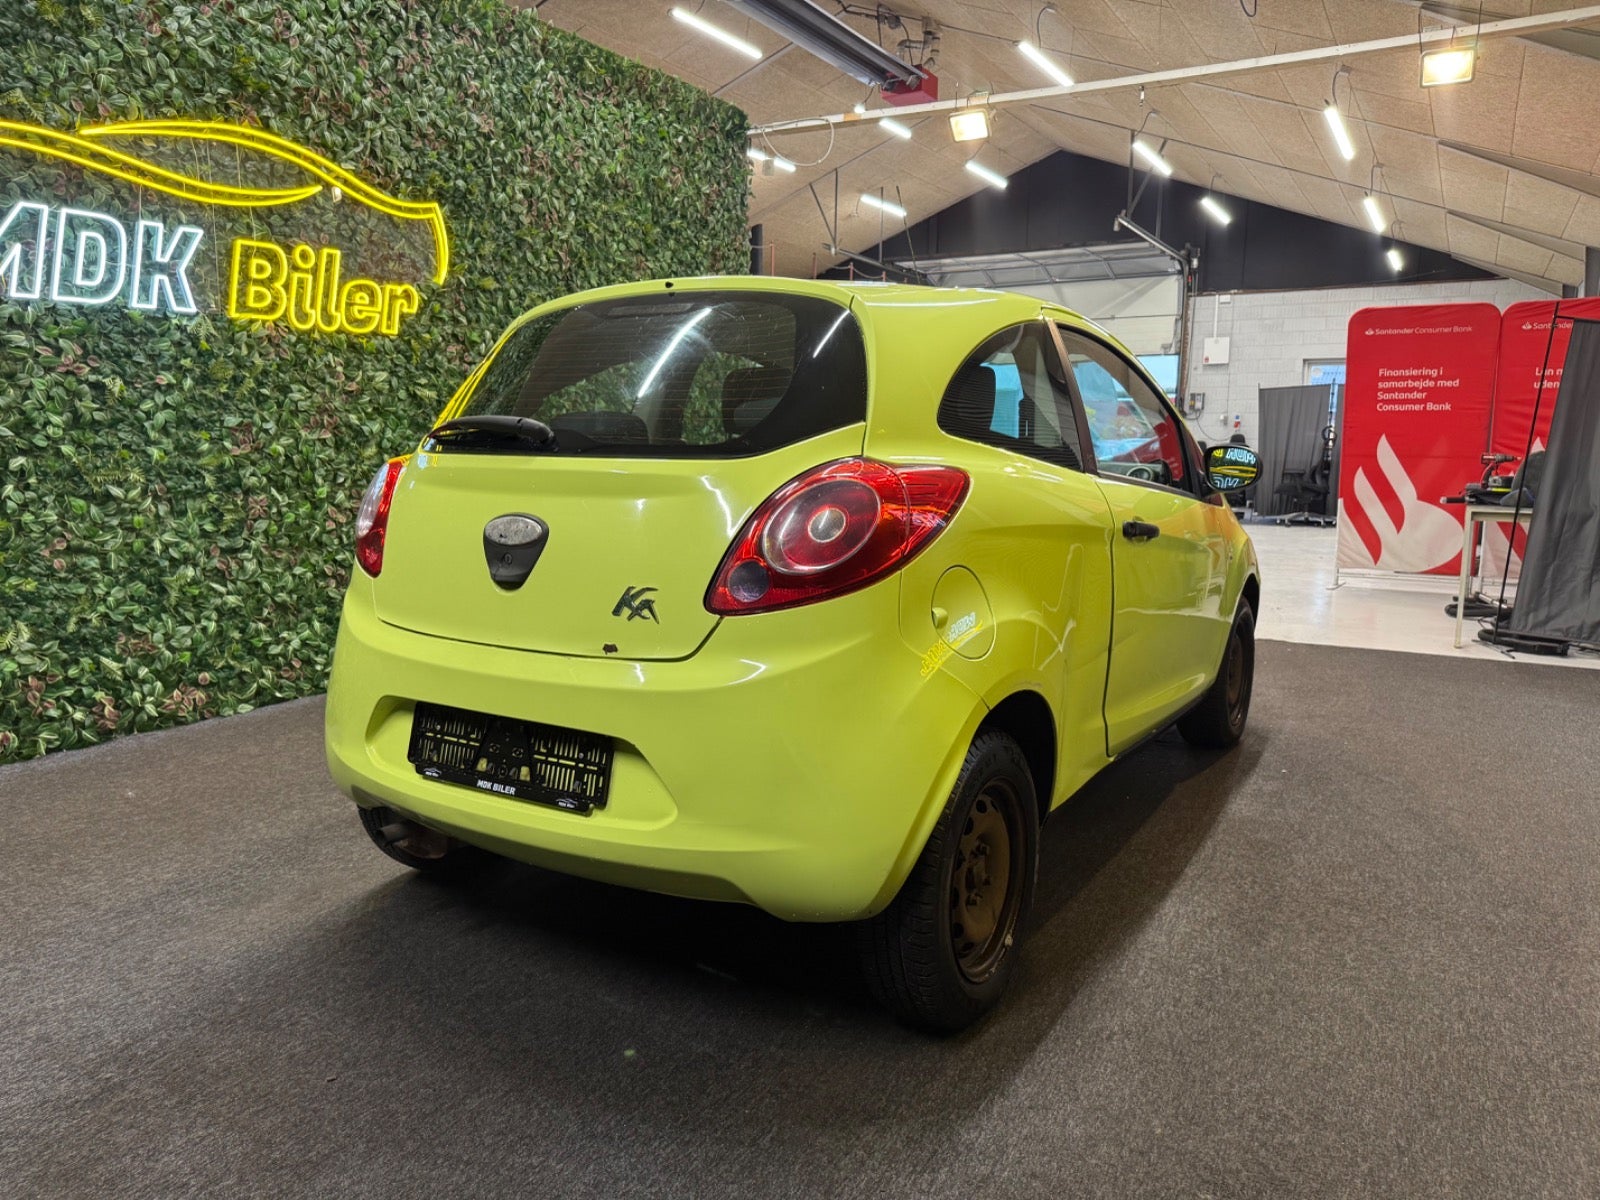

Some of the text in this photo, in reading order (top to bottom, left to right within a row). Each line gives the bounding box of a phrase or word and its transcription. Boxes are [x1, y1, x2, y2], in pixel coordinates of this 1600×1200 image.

[227, 238, 419, 336] Biler
[1375, 325, 1473, 336] Santander Consumer Bank
[1378, 366, 1443, 378] Finansiering i
[1377, 378, 1460, 390] samarbejde med
[1376, 391, 1427, 401] Santander
[1376, 402, 1452, 412] Consumer Bank
[492, 783, 516, 795] BILER
